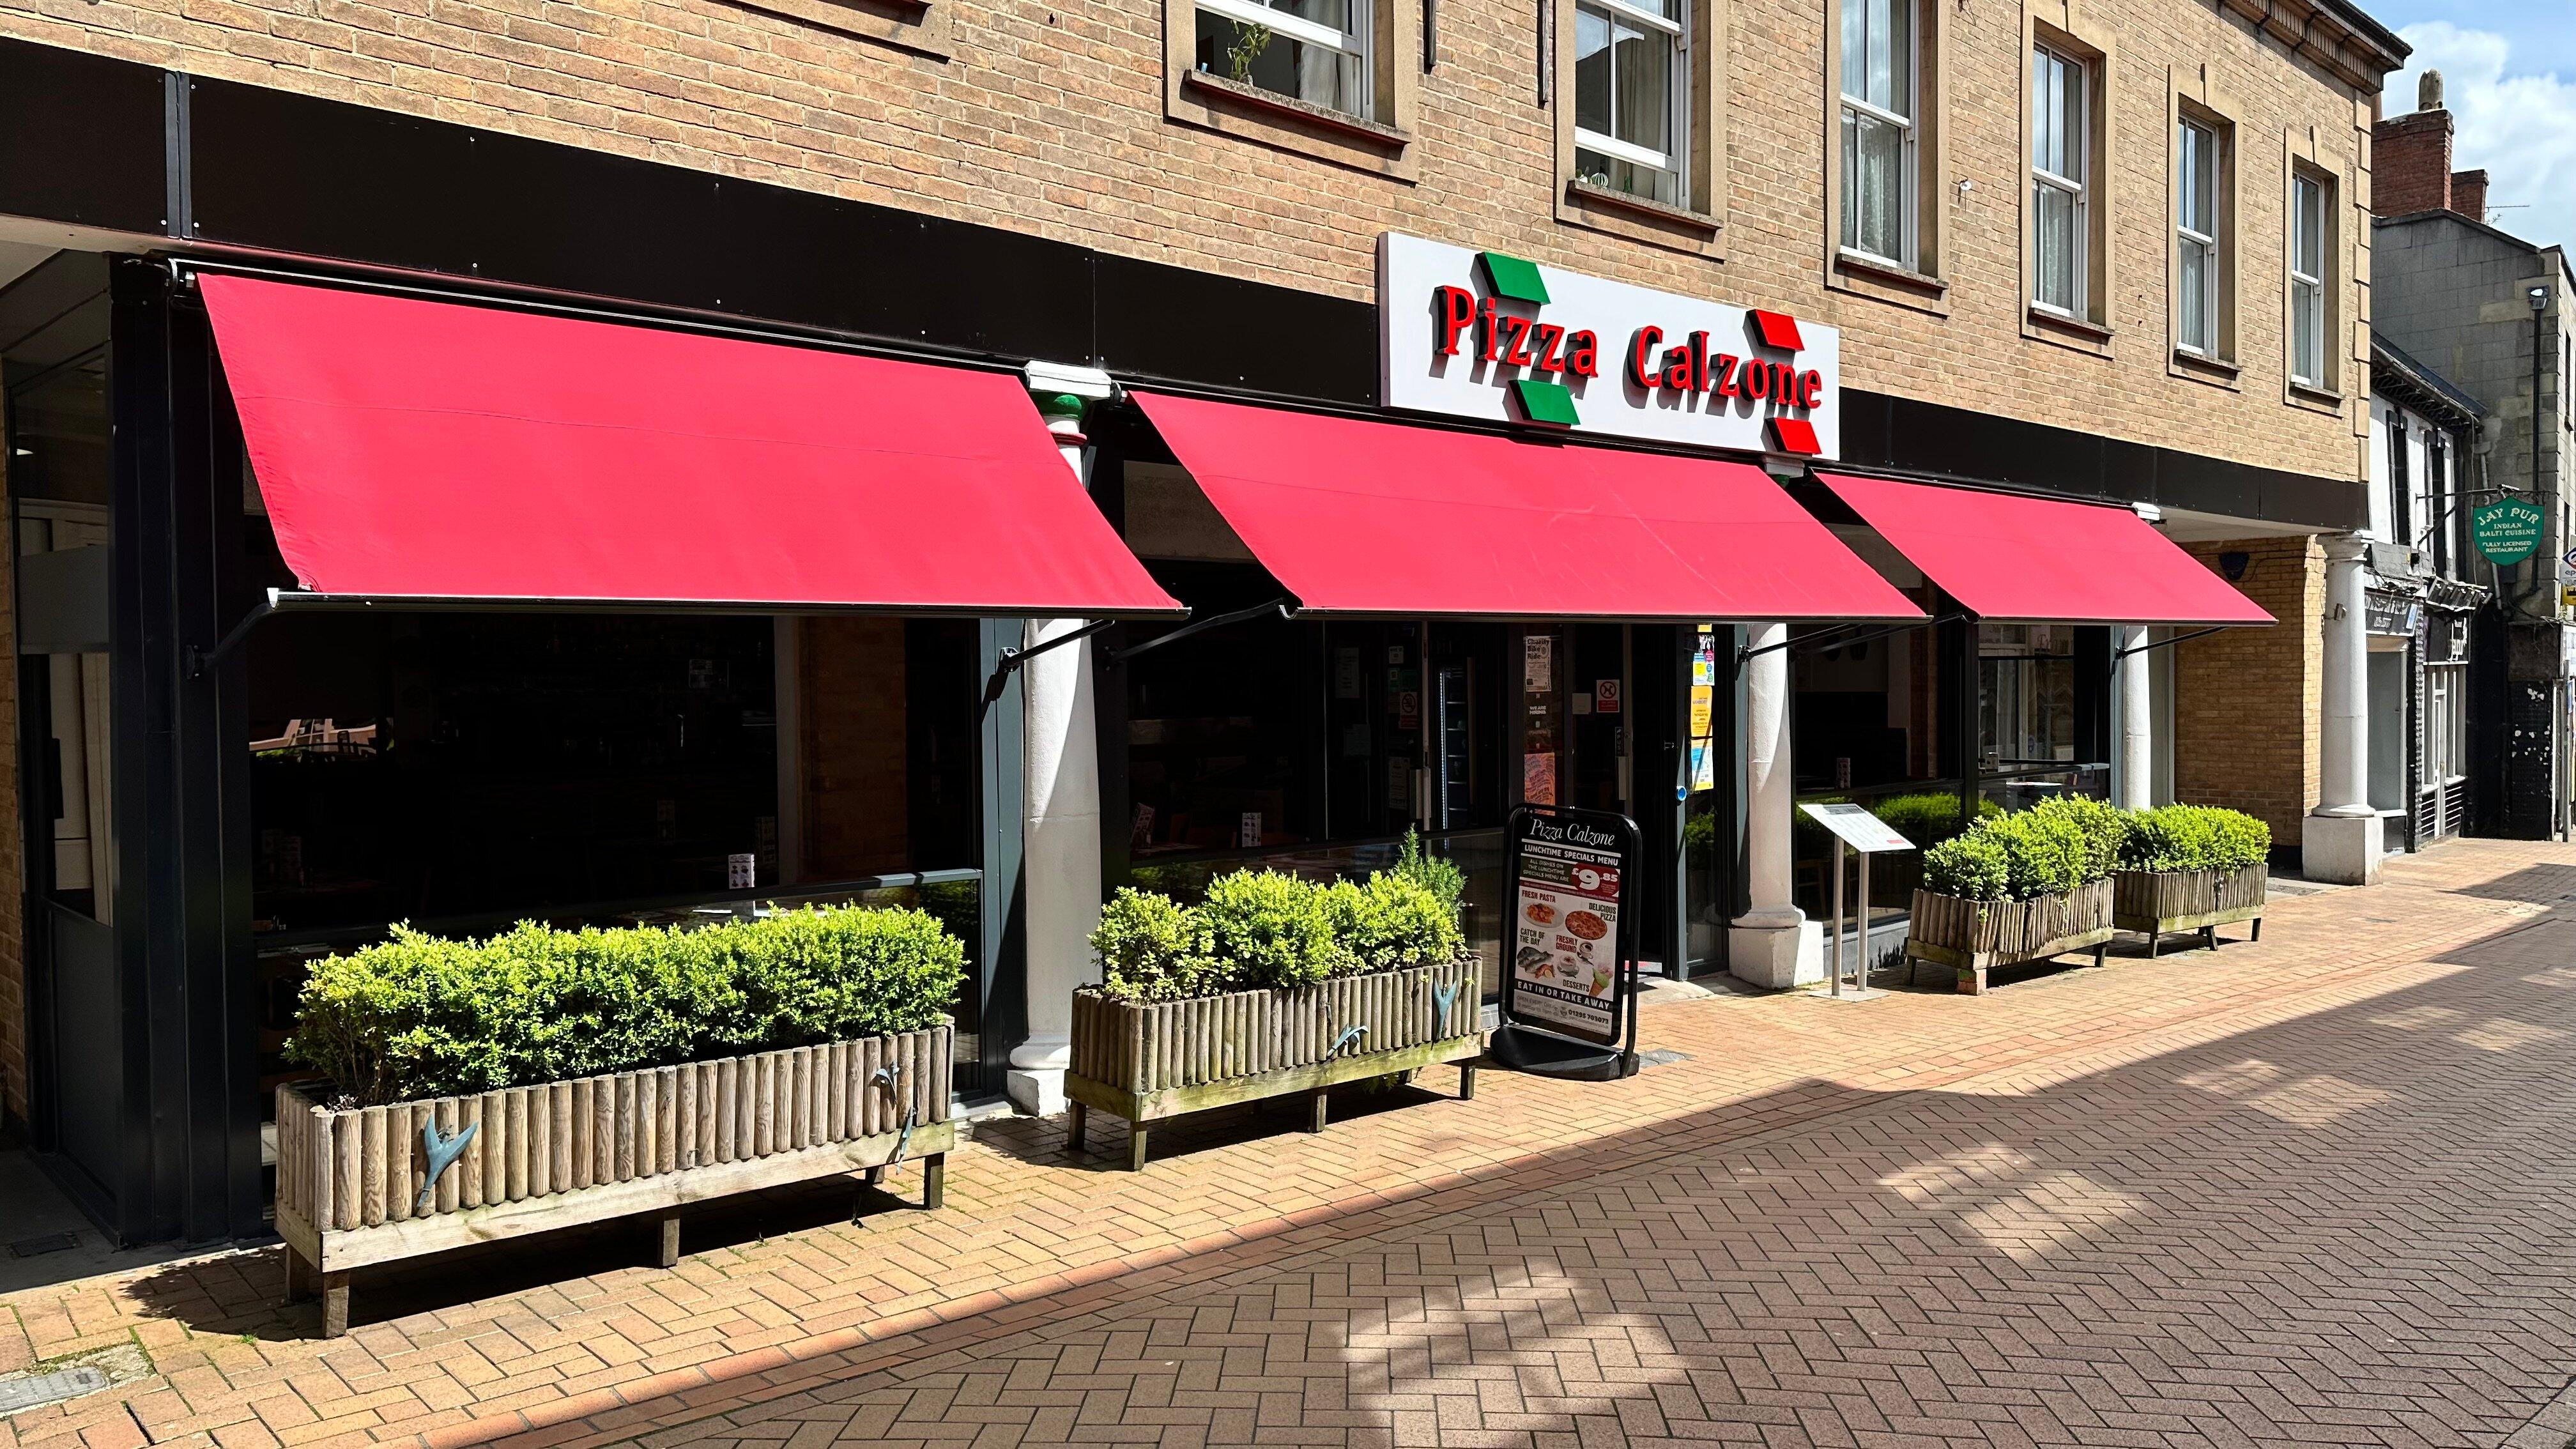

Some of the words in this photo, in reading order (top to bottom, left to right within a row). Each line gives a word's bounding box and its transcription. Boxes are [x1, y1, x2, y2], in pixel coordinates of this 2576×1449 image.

[1434, 285, 1598, 378] Pizza
[1628, 325, 1823, 409] Calzone
[2478, 508, 2503, 526] JAY
[2510, 507, 2539, 525] PUR
[1529, 818, 1563, 840] Pizza
[1567, 824, 1614, 846] Calzone
[1524, 844, 1561, 857] LUNCHTIME
[1564, 850, 1595, 862] SPECIALS
[1597, 856, 1618, 866] MENU
[1523, 870, 1544, 878] SPECIALS
[1538, 866, 1565, 875] LUNCHTIME
[1571, 868, 1618, 891] £9.85
[1522, 890, 1538, 899] FRESH
[1539, 893, 1556, 903] PASTA
[1589, 903, 1616, 914] DELICIOUS
[1600, 912, 1616, 922] PIZZA
[1521, 928, 1537, 937] CATCH
[1520, 935, 1529, 944] THE
[1531, 937, 1540, 946] DAY
[1556, 935, 1578, 946] FRESHLY
[1556, 942, 1577, 953] GROUND
[1563, 979, 1590, 992] DESSERTS
[1517, 981, 1533, 991] EAT
[1535, 986, 1544, 994] IN
[1547, 988, 1558, 997] OR
[1560, 991, 1582, 1003] TAKE
[1584, 998, 1610, 1010] AWAY
